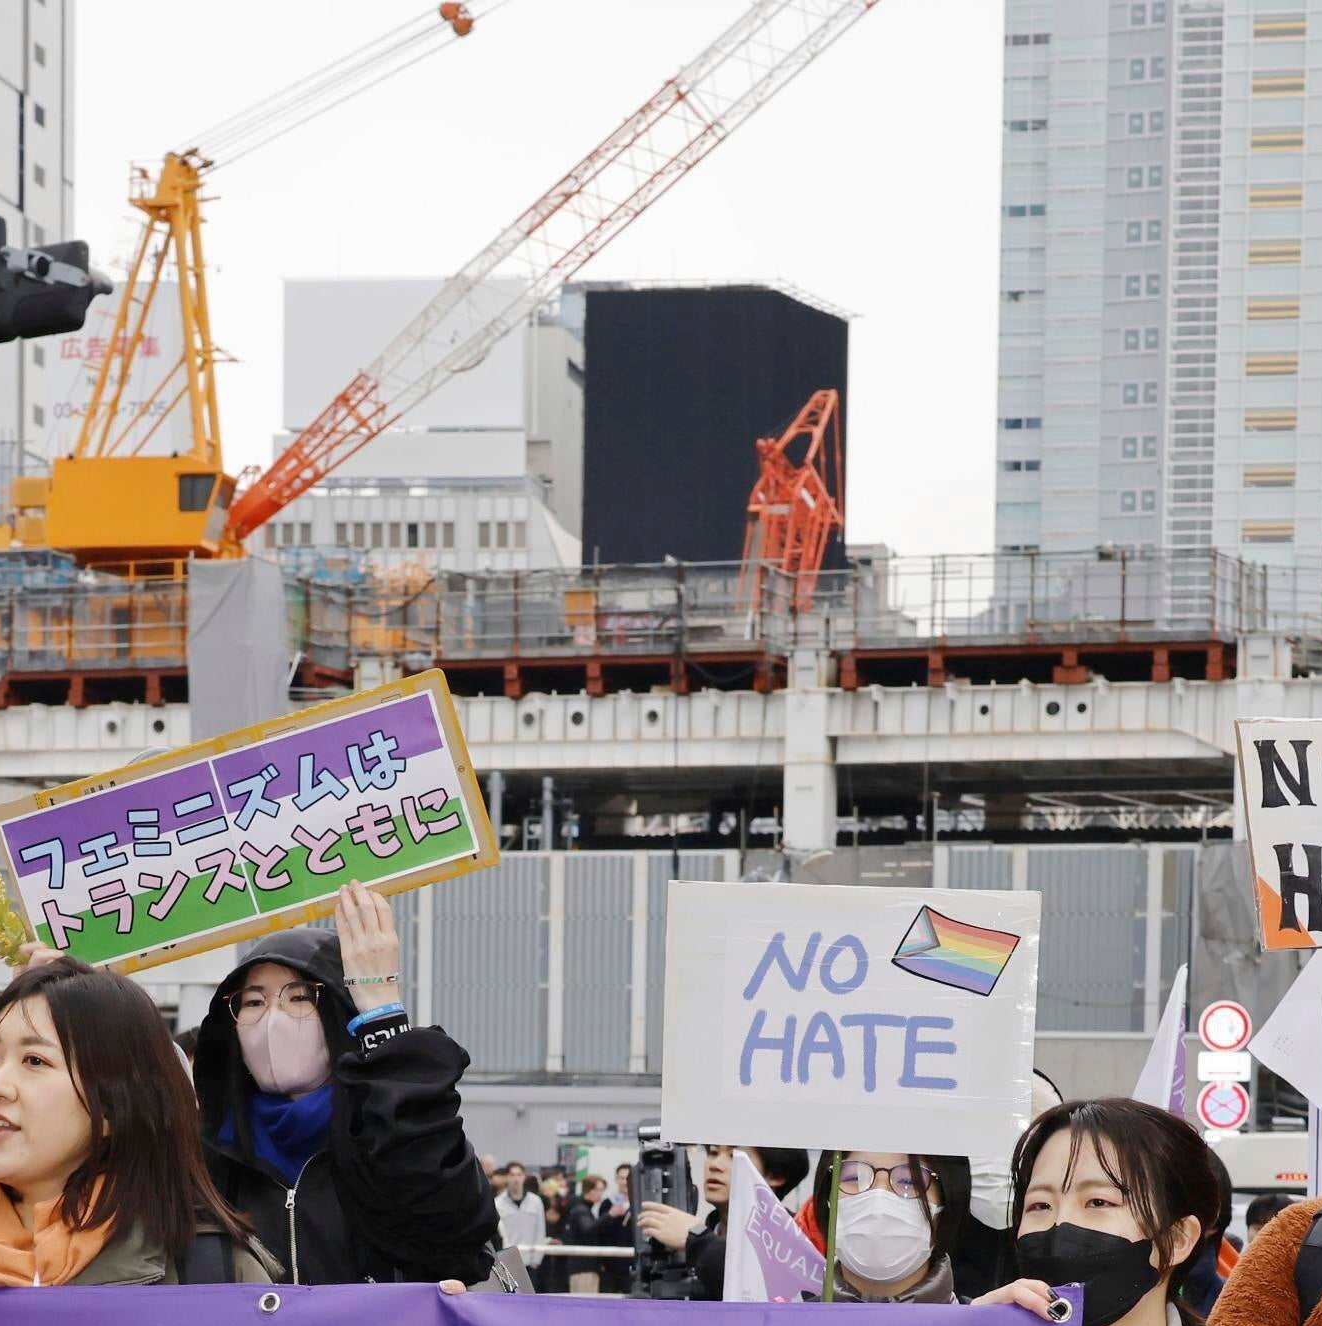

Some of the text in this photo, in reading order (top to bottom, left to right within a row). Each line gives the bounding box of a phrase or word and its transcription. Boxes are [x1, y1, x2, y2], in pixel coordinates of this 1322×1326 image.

[19, 729, 407, 890] フェミニズムは
[41, 786, 462, 951] トランスとともに
[743, 931, 869, 1001] NO
[739, 1009, 958, 1093] HATE
